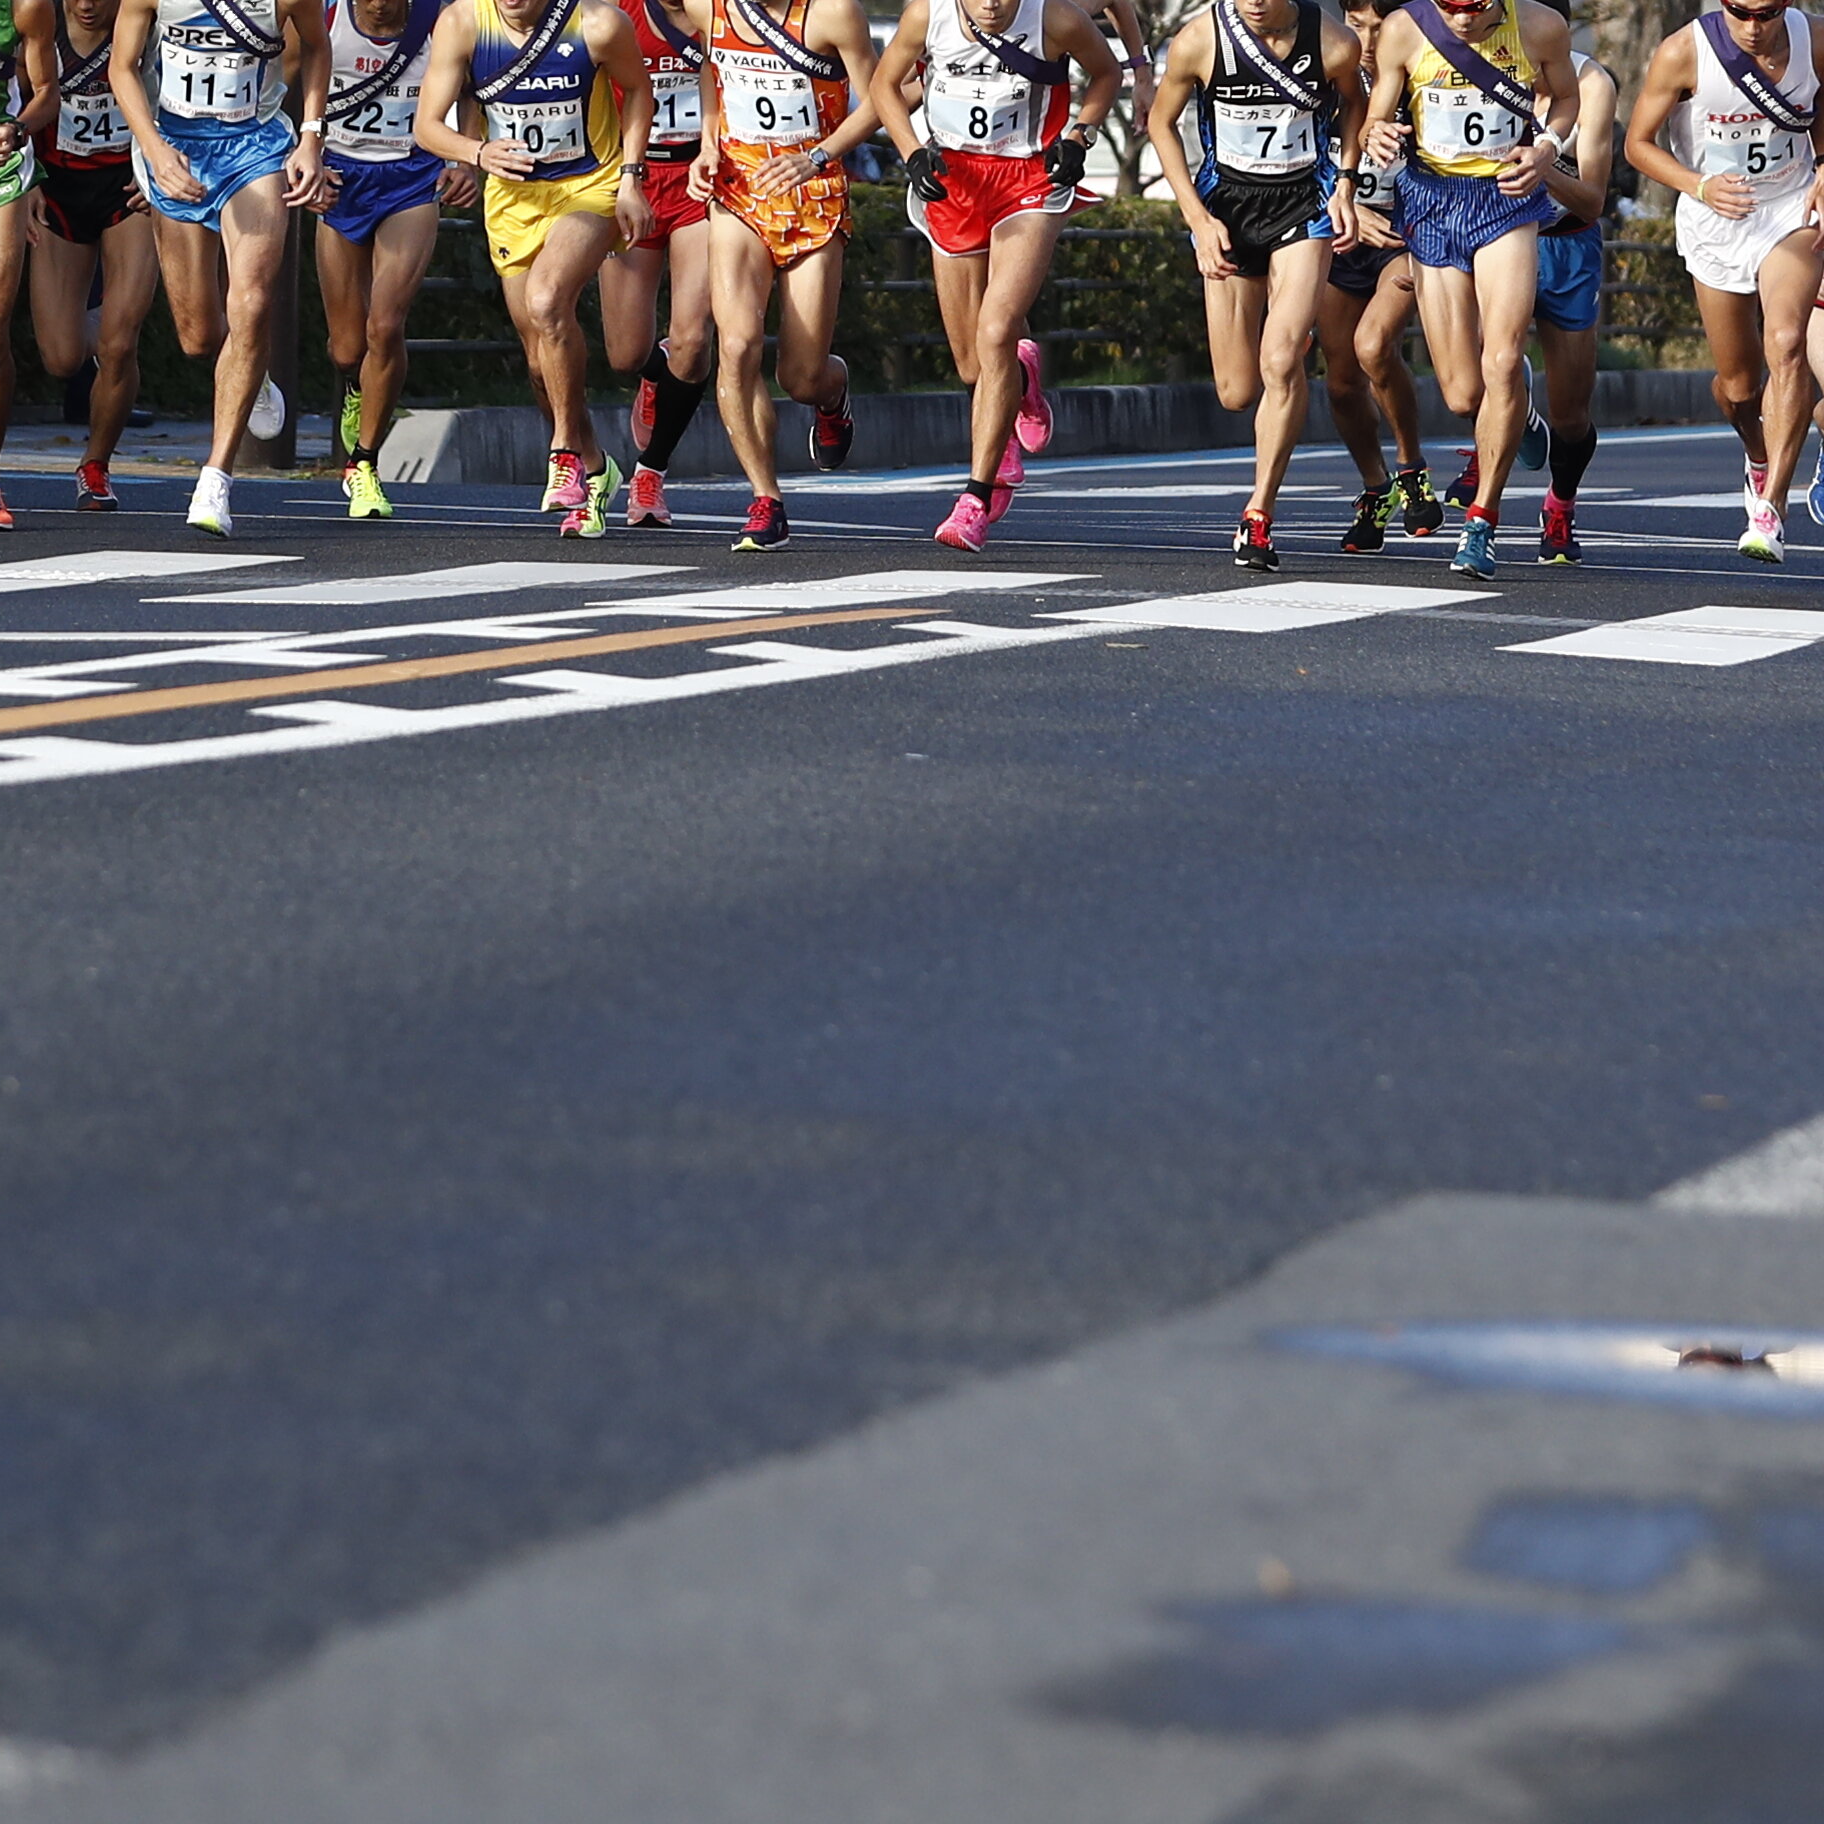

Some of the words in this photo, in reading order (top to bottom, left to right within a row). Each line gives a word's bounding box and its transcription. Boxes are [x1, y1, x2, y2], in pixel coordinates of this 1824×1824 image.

[659, 56, 693, 71] 日本
[1451, 65, 1518, 86] 日流
[181, 72, 252, 106] 11-1
[725, 71, 807, 91] 八千代工業
[934, 79, 1026, 101] 富士通
[61, 95, 117, 111] 東京消
[342, 101, 415, 134] 22-1
[755, 96, 811, 130] 9-1
[506, 121, 578, 153] 10-1
[968, 106, 1020, 140] 8-1
[1463, 111, 1516, 146] 6-1
[1256, 126, 1308, 159] 7-1
[1747, 137, 1794, 174] 5-1
[1357, 172, 1394, 199] 9-
